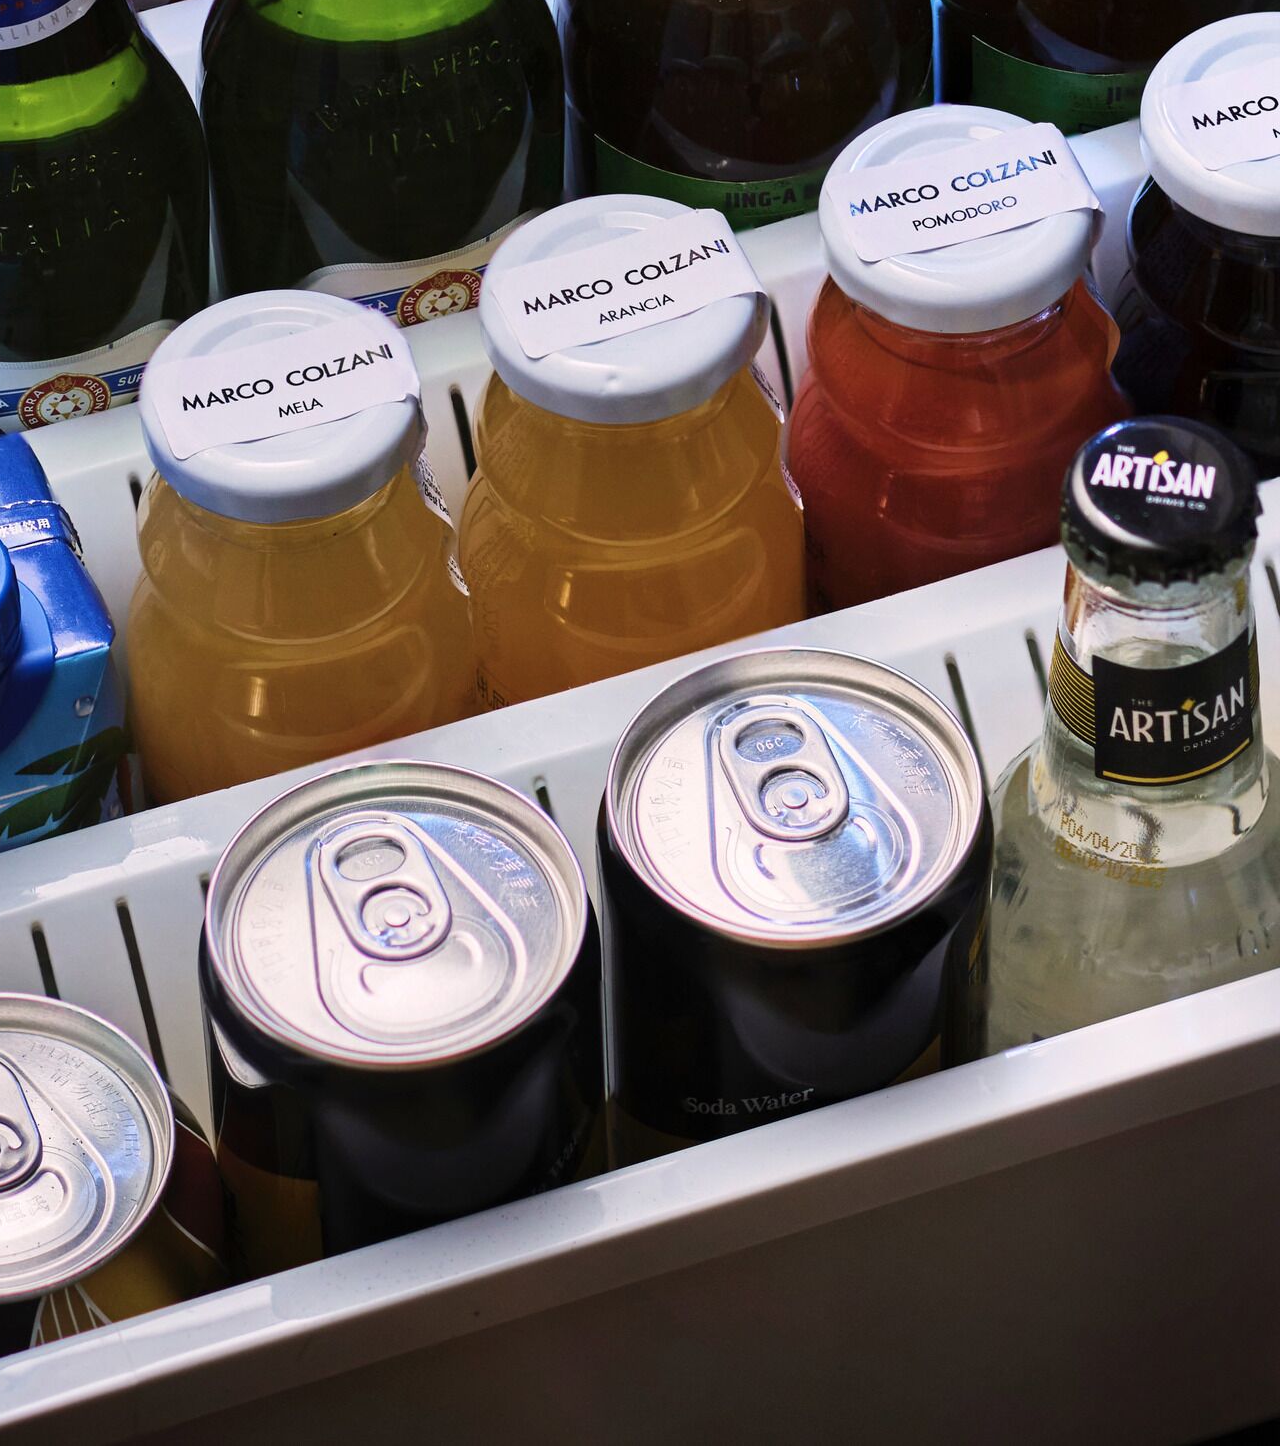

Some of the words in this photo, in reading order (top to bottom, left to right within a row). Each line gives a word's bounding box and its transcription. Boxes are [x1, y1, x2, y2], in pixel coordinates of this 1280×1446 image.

[1192, 96, 1279, 130] MARCO
[850, 184, 939, 216] MARCO
[951, 150, 1057, 192] COLZANI
[912, 195, 1017, 231] POMODORO
[523, 279, 613, 314] MARCO
[624, 239, 730, 285] COLZANI
[404, 288, 424, 323] BIRRA
[599, 294, 674, 325] ARANCIA
[182, 379, 273, 411] MARCO
[286, 344, 393, 387] COLZANI
[23, 389, 45, 426] BIRRA
[278, 398, 323, 417] MELA
[1132, 699, 1153, 707] THE
[1183, 731, 1225, 753] DRINKS
[683, 1097, 738, 1115] Soda
[741, 1087, 814, 1114] Water
